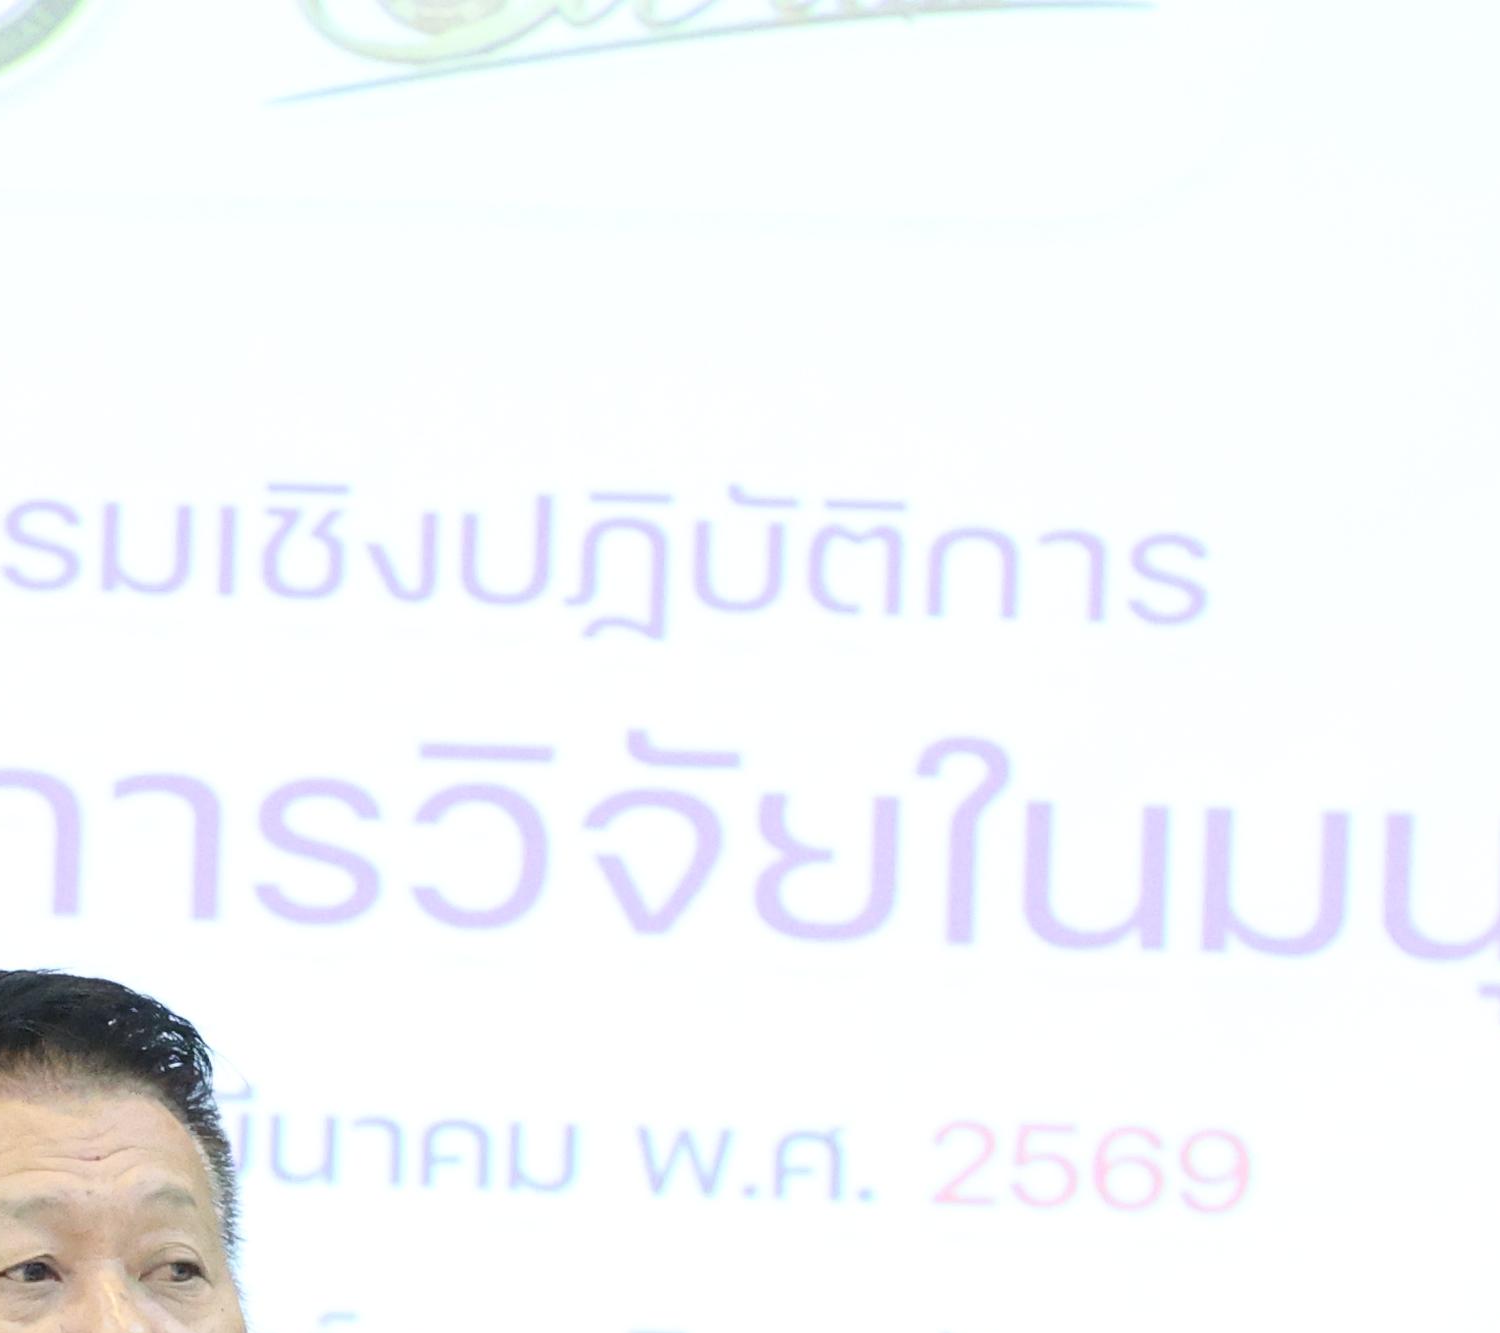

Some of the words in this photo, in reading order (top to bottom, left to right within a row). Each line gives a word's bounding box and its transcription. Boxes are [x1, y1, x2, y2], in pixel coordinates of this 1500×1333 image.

[212, 1085, 583, 1194] ีนาคม
[636, 1124, 879, 1205] พ.ศ.
[934, 1121, 1254, 1214] 2569
